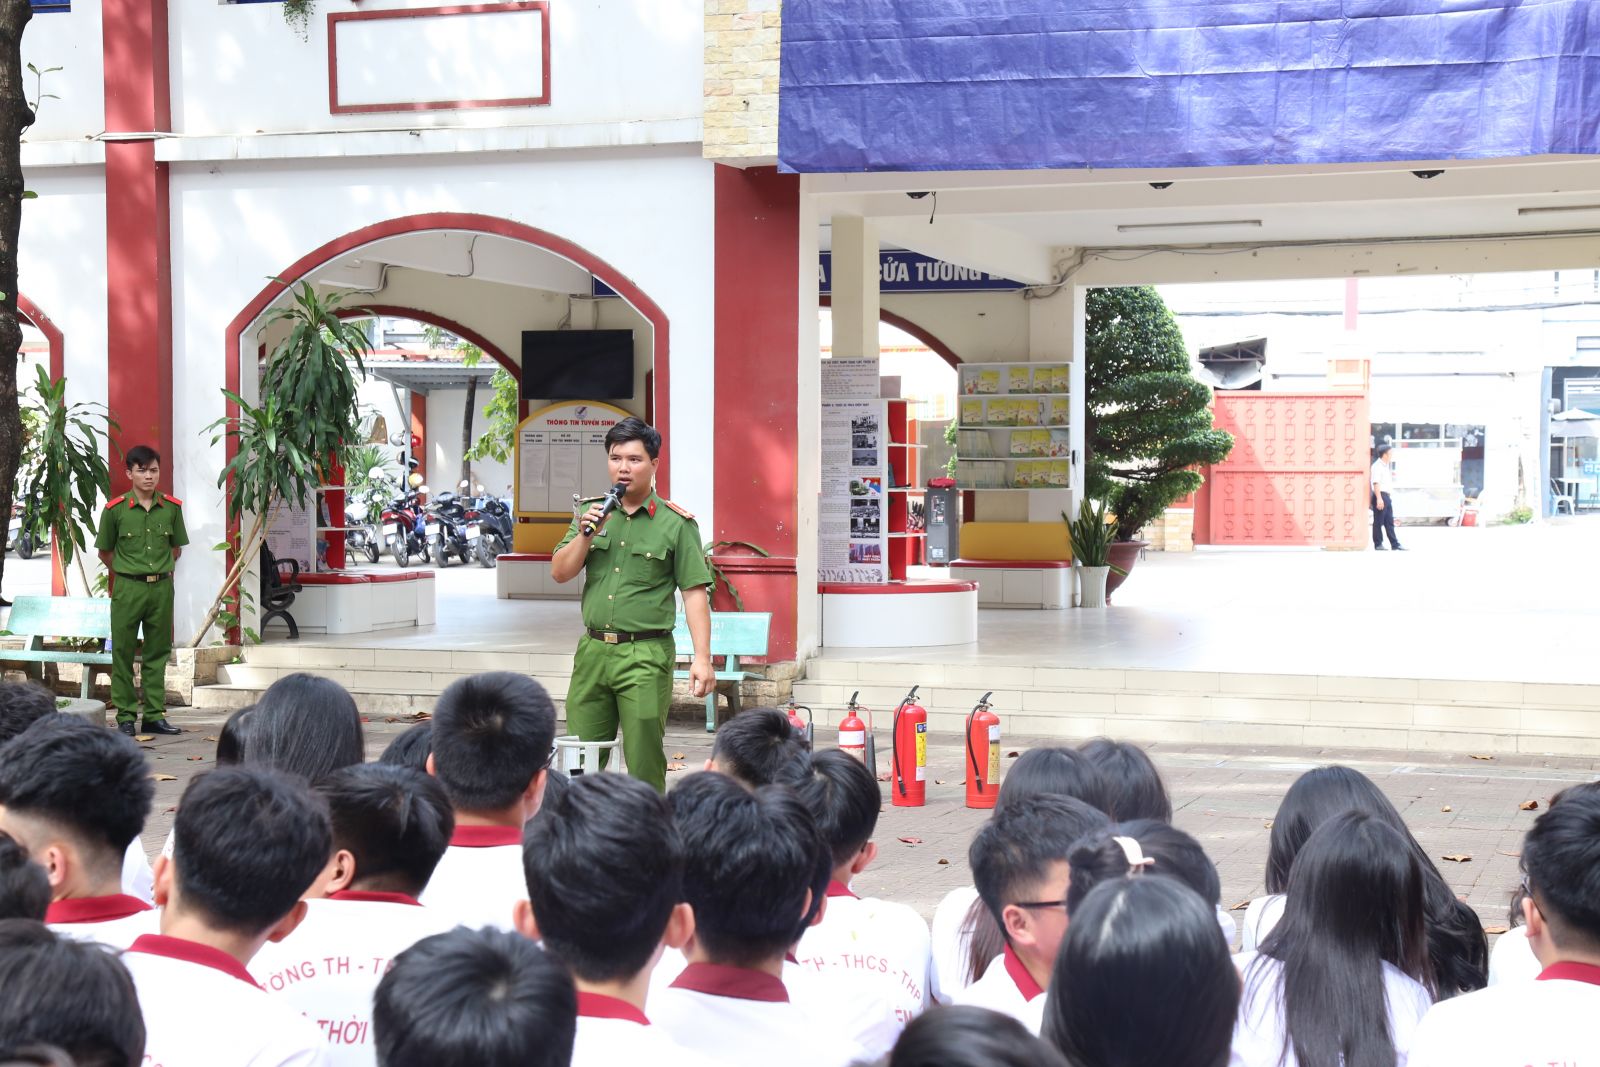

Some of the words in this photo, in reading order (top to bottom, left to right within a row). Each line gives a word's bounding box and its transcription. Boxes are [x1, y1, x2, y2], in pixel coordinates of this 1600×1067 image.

[262, 961, 316, 991] ỜNG
[323, 956, 350, 975] TH
[840, 954, 888, 973] THCS
